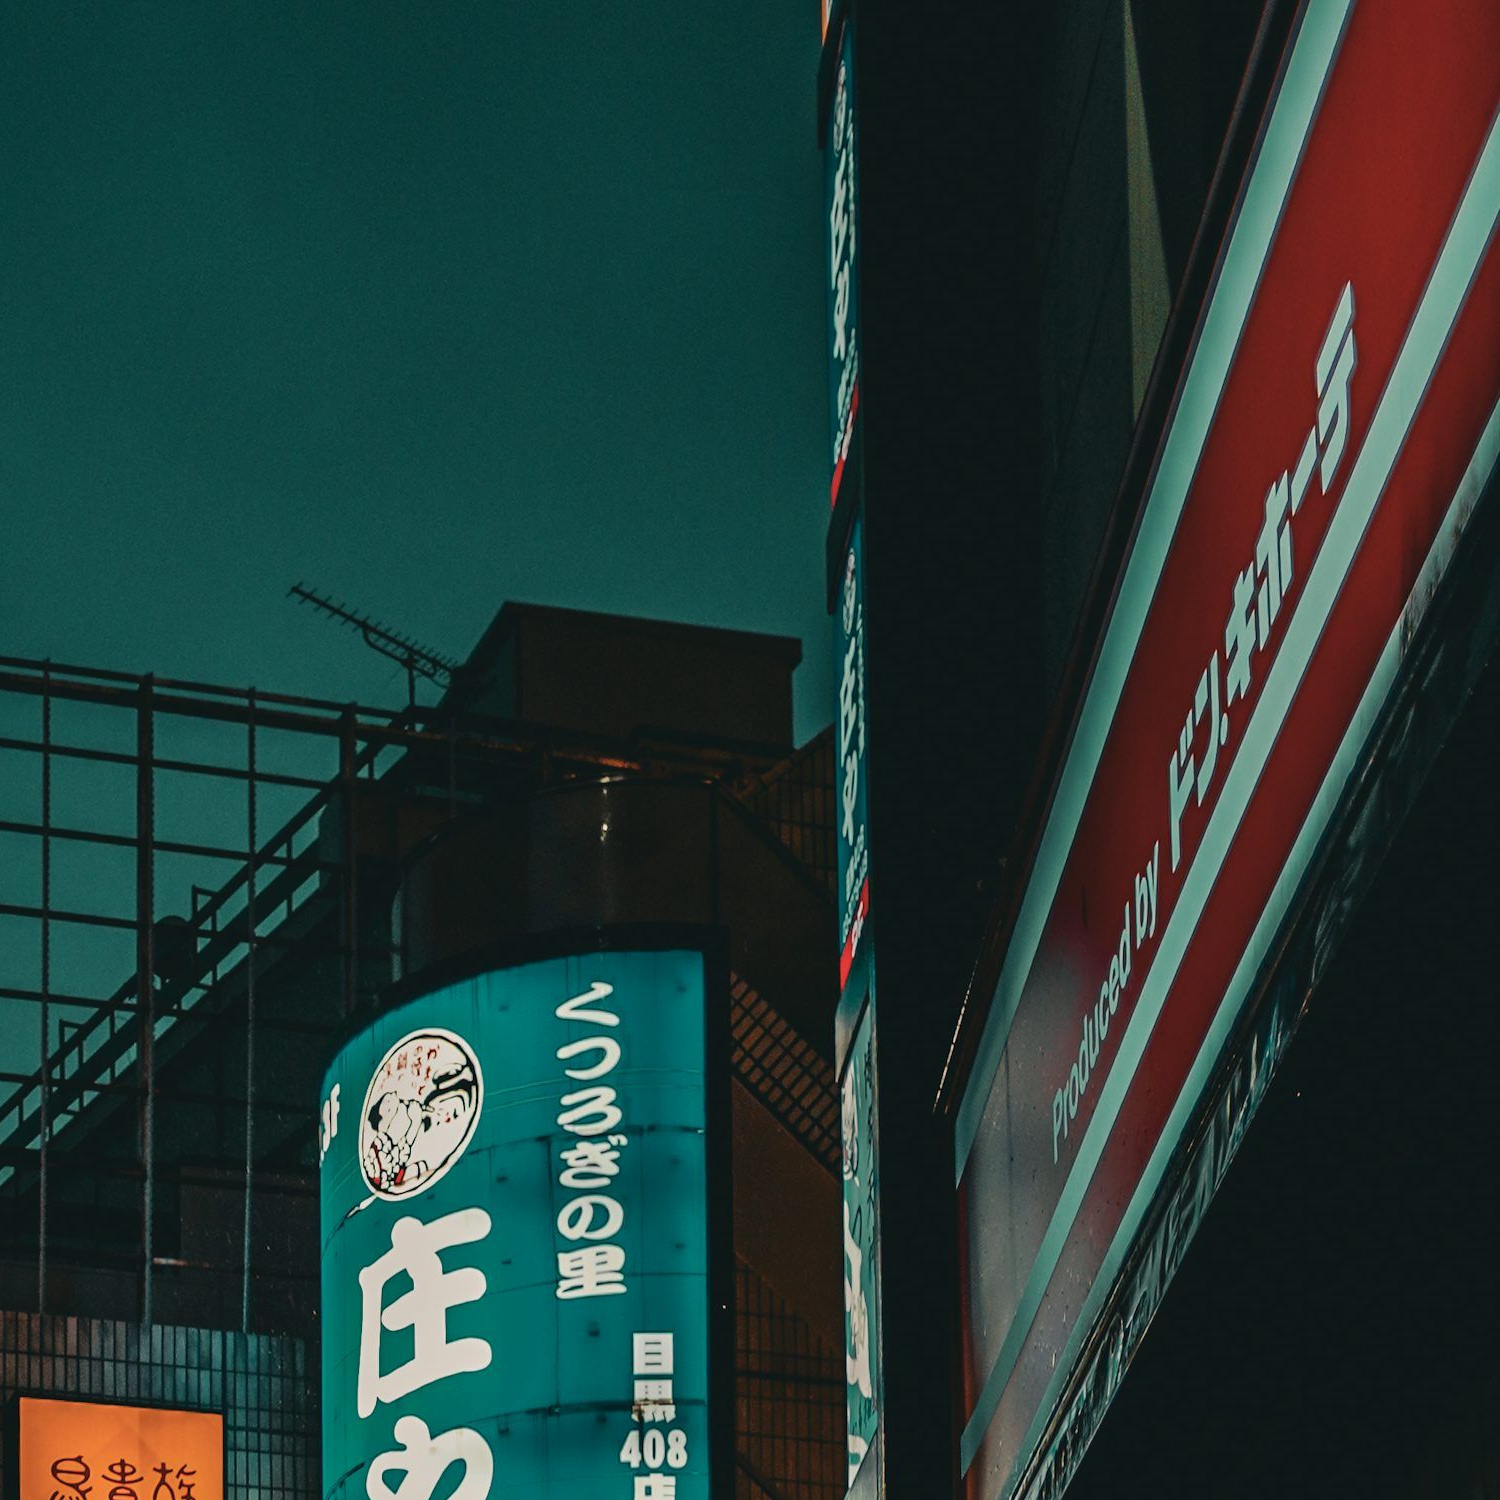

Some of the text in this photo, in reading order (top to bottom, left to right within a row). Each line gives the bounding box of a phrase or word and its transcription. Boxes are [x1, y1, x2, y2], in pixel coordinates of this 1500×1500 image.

[556, 981, 627, 1299] くつろぎの里
[1052, 840, 1159, 1165] Produced by
